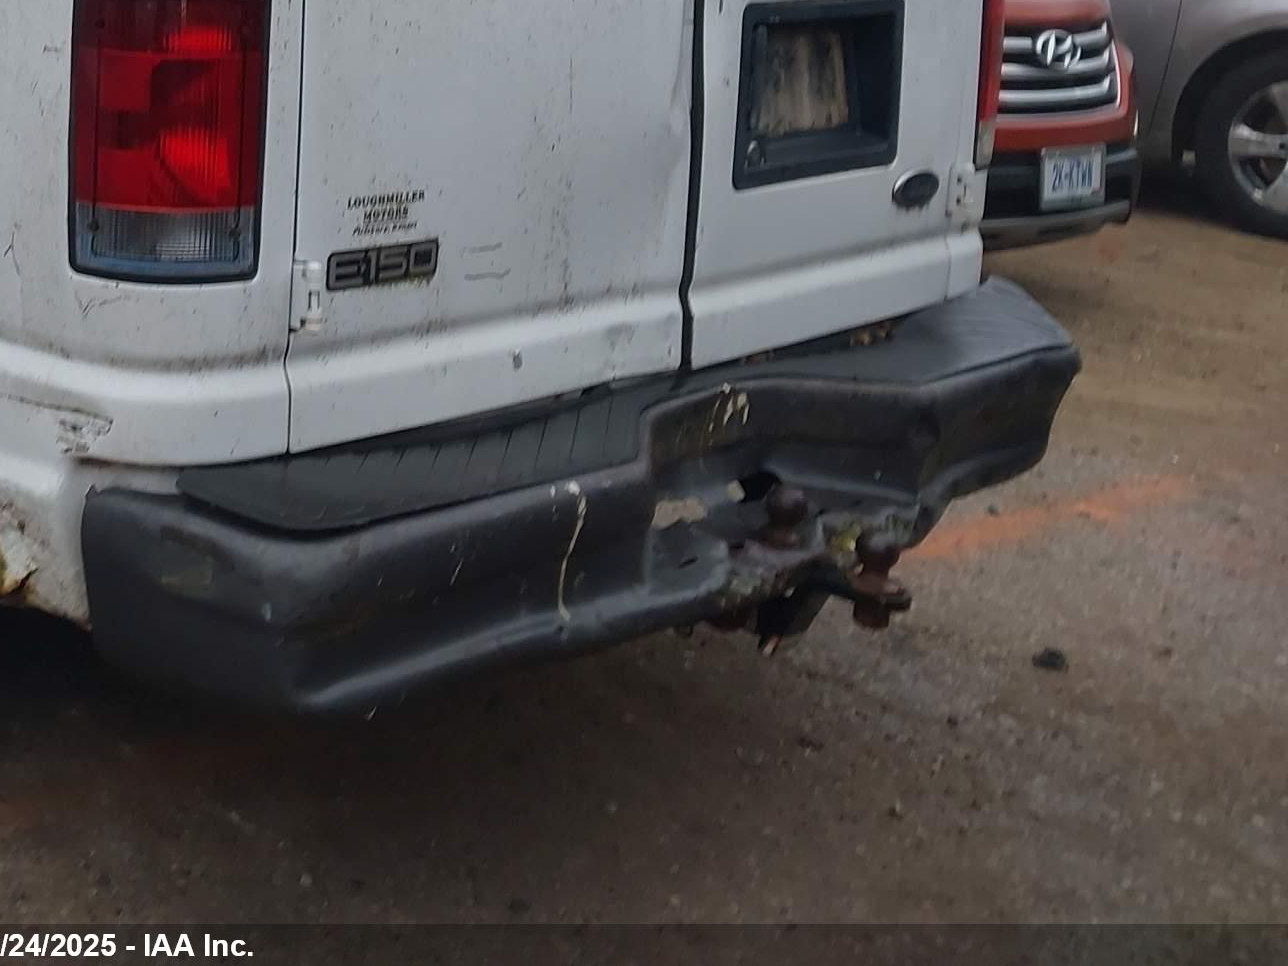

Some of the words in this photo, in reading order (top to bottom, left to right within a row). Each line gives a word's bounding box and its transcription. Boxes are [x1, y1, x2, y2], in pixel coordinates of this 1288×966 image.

[347, 189, 425, 210] LOUGHMILLER
[363, 205, 409, 223] MOTORS
[327, 239, 438, 291] E150
